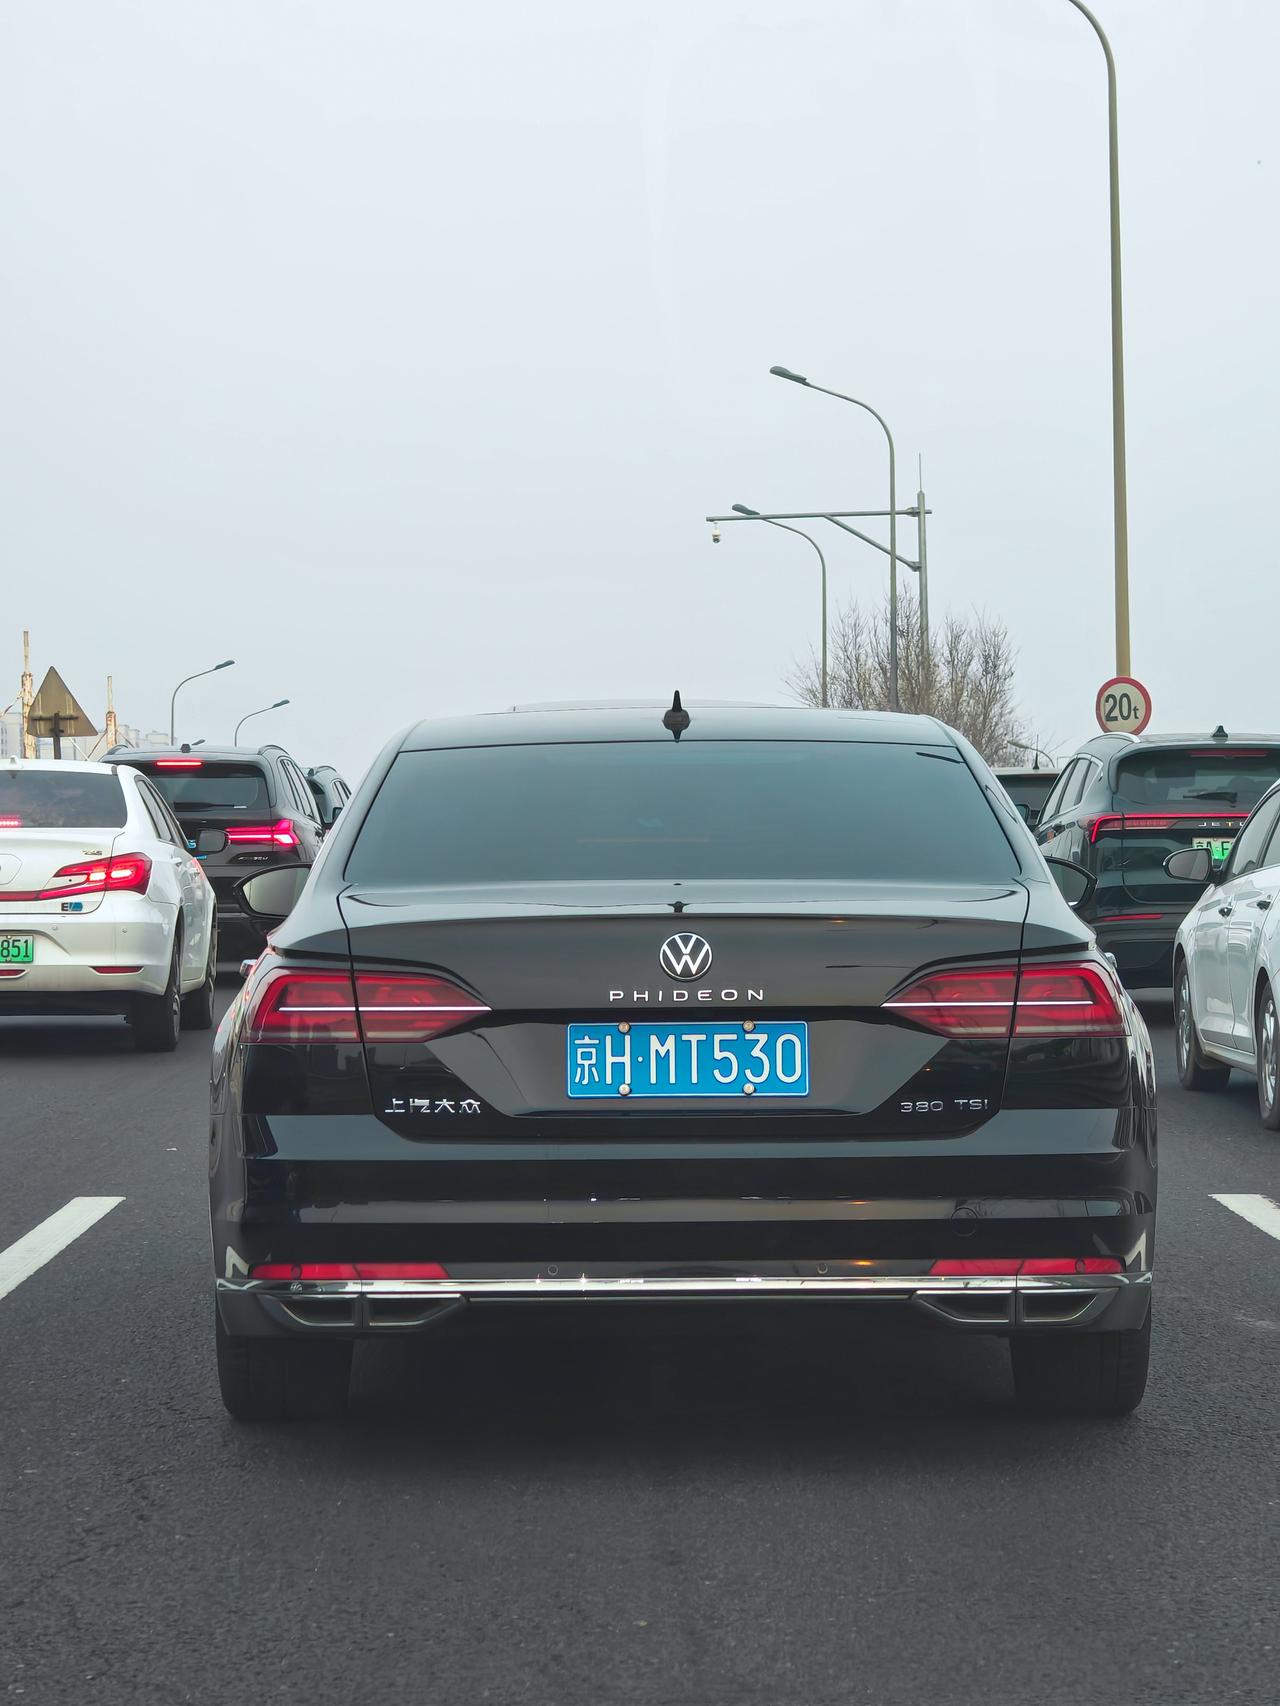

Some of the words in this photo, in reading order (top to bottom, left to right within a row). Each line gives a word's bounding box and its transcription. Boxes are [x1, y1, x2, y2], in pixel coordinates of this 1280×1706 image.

[0, 939, 30, 958] 851
[609, 989, 764, 1002] PHIDEON
[384, 1098, 481, 1113] 上汽大众
[900, 1101, 944, 1113] 380
[954, 1099, 988, 1111] TSI
